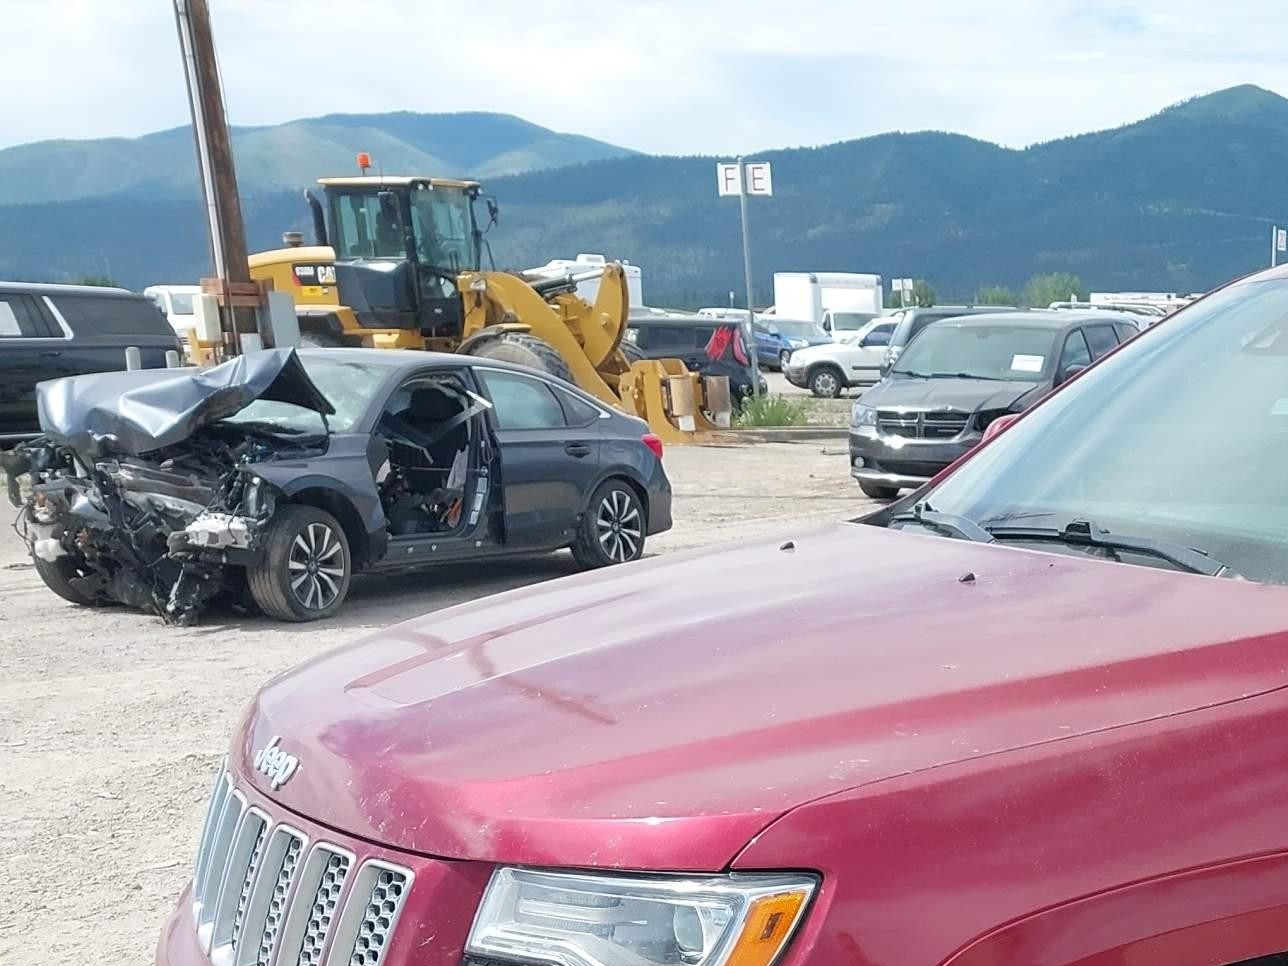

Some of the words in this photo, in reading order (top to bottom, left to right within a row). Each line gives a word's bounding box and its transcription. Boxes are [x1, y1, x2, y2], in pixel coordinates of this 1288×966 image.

[724, 167, 735, 191] F
[752, 167, 765, 191] E
[317, 266, 336, 283] CA
[254, 735, 300, 791] Jeep
